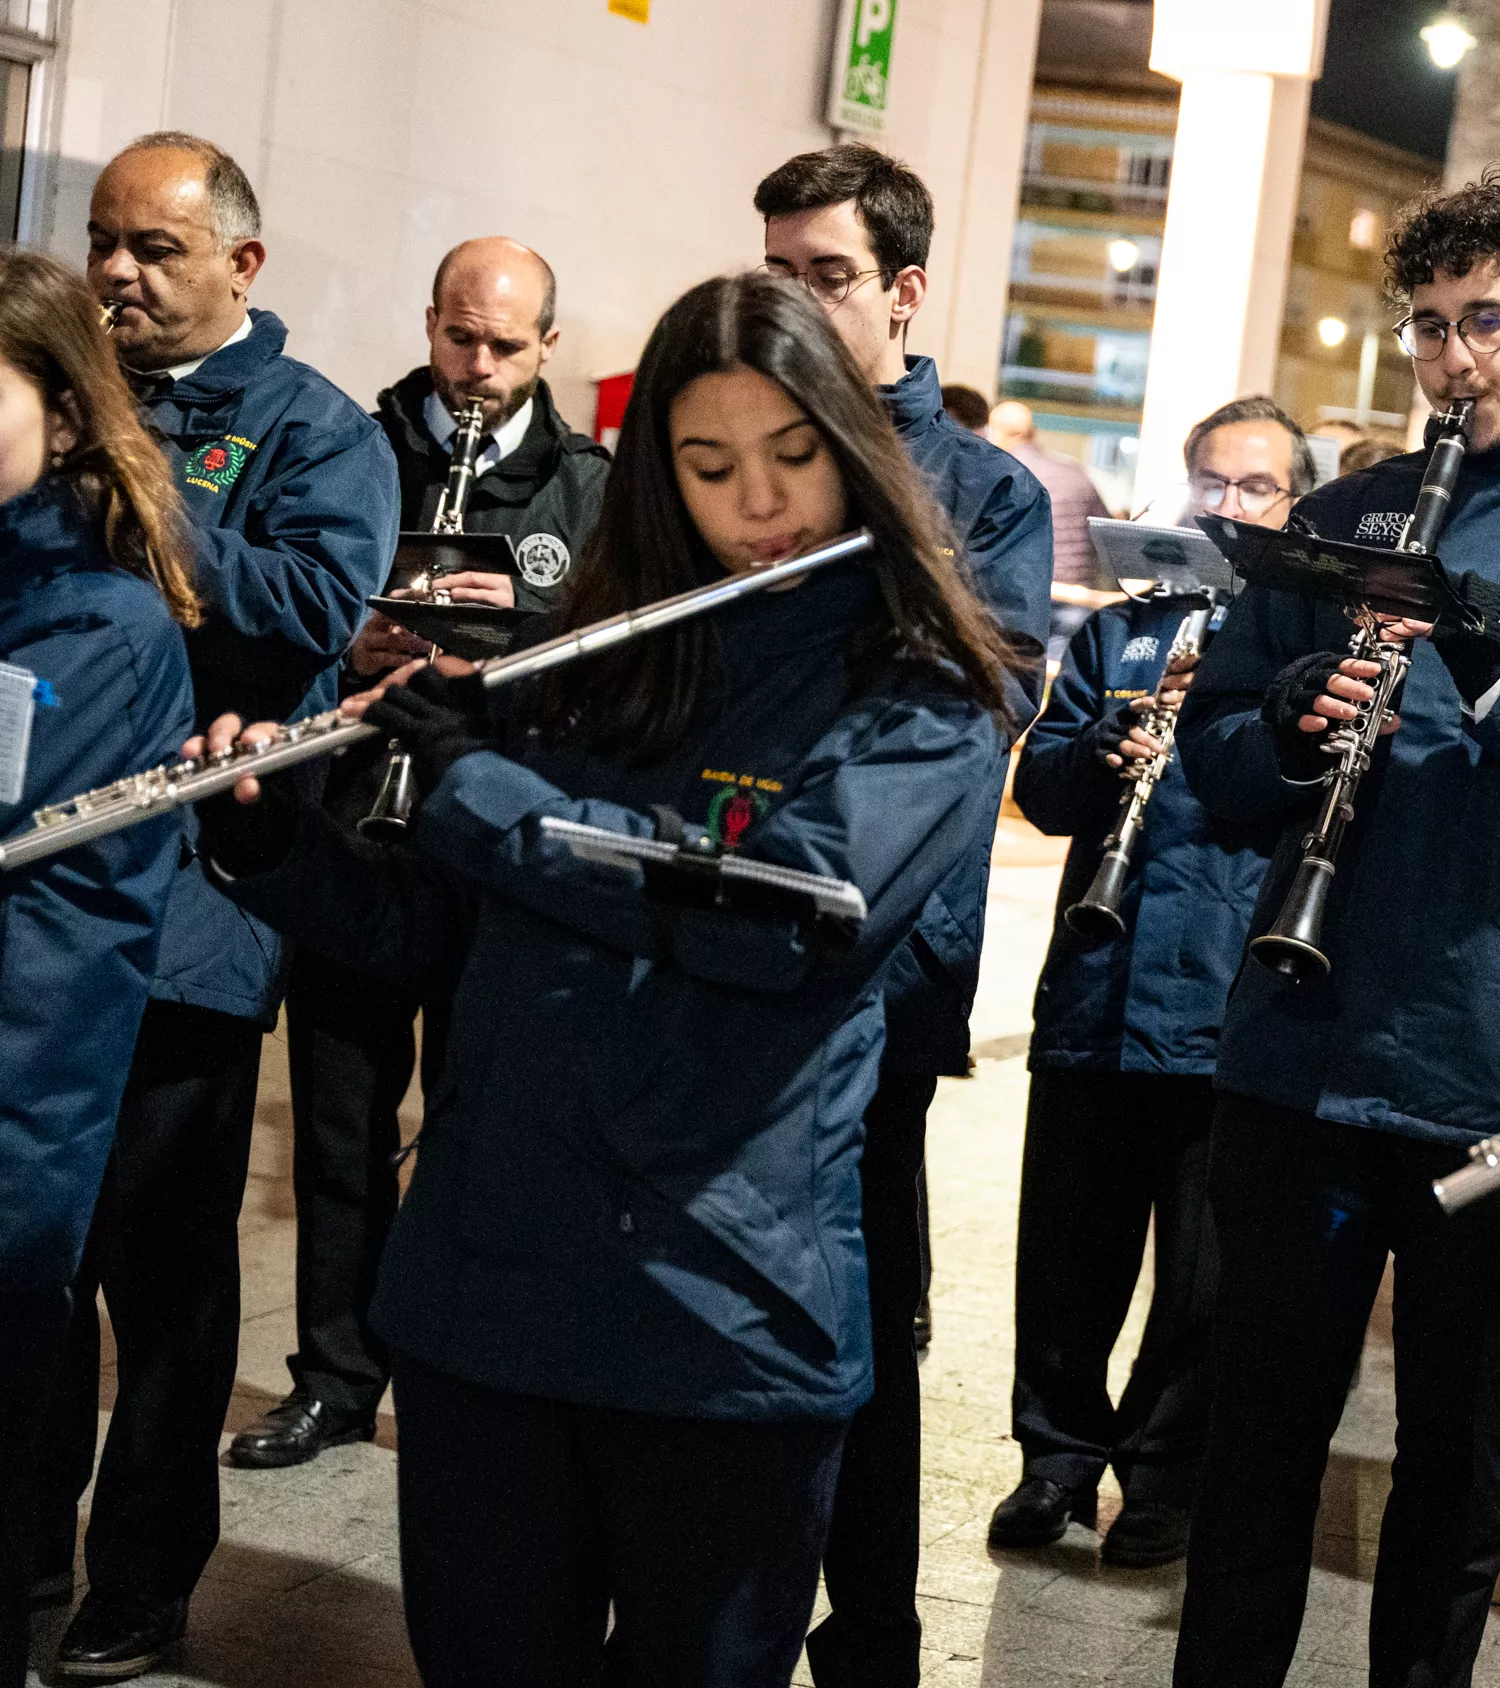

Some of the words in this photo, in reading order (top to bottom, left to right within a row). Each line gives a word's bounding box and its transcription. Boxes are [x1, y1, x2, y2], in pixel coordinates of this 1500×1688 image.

[858, 0, 890, 46] P
[186, 476, 219, 494] LUCENA
[1361, 512, 1407, 524] GRUPO
[1356, 522, 1404, 538] SEYS
